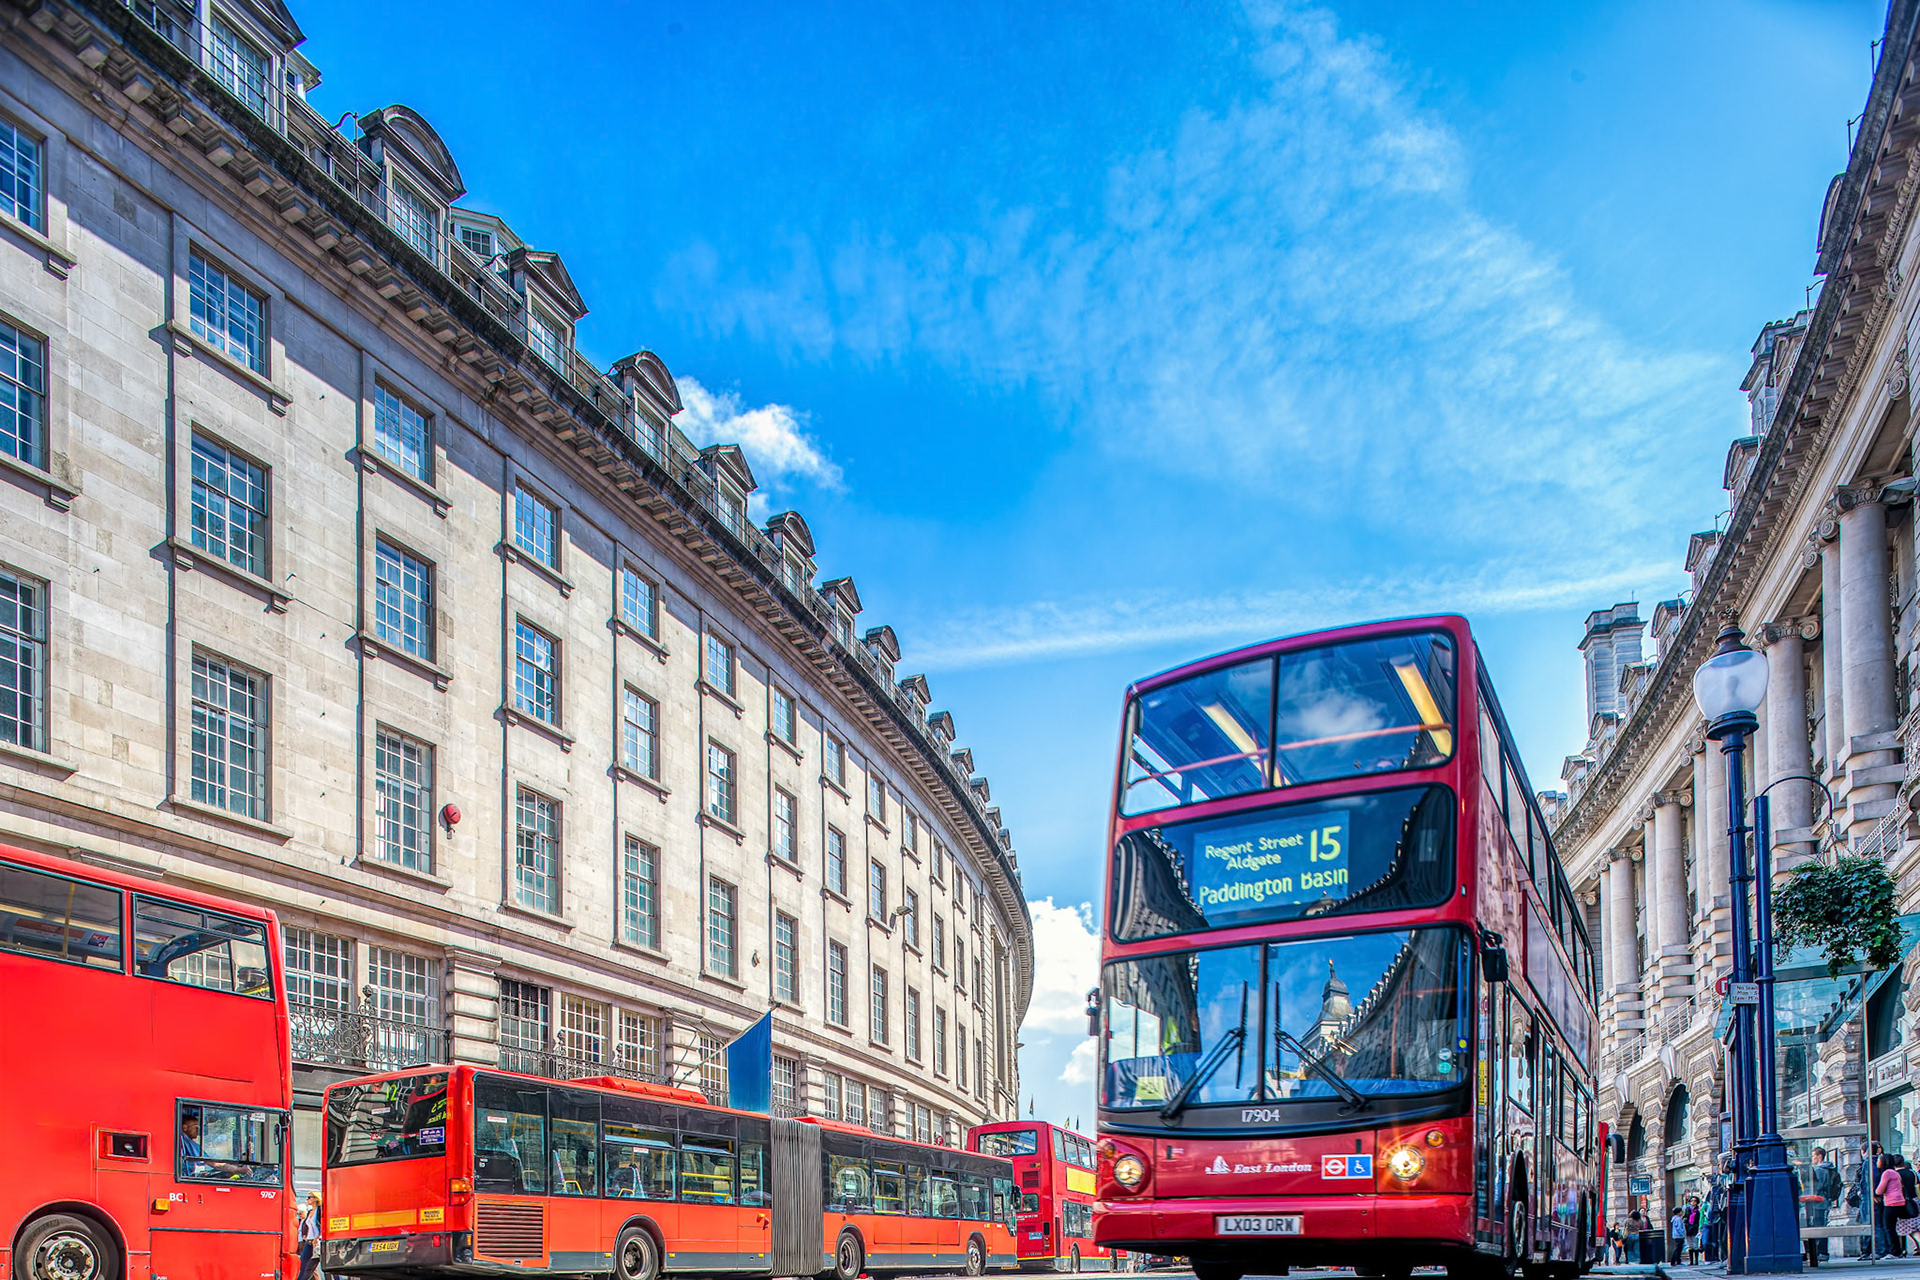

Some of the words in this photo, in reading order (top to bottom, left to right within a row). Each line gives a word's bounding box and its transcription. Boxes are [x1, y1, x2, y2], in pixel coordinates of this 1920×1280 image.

[1205, 841, 1254, 860] Regent
[1258, 834, 1304, 851] Street
[1310, 825, 1342, 863] 15
[1225, 853, 1282, 871] Aldgate
[1199, 877, 1293, 906] Paddington
[386, 1084, 397, 1101] 12
[1241, 1109, 1281, 1123] 17904
[1233, 1164, 1262, 1174] East
[1265, 1162, 1312, 1173] London
[260, 1191, 277, 1199] 9767
[1224, 1218, 1261, 1232] LX03
[1265, 1218, 1294, 1232] ORW
